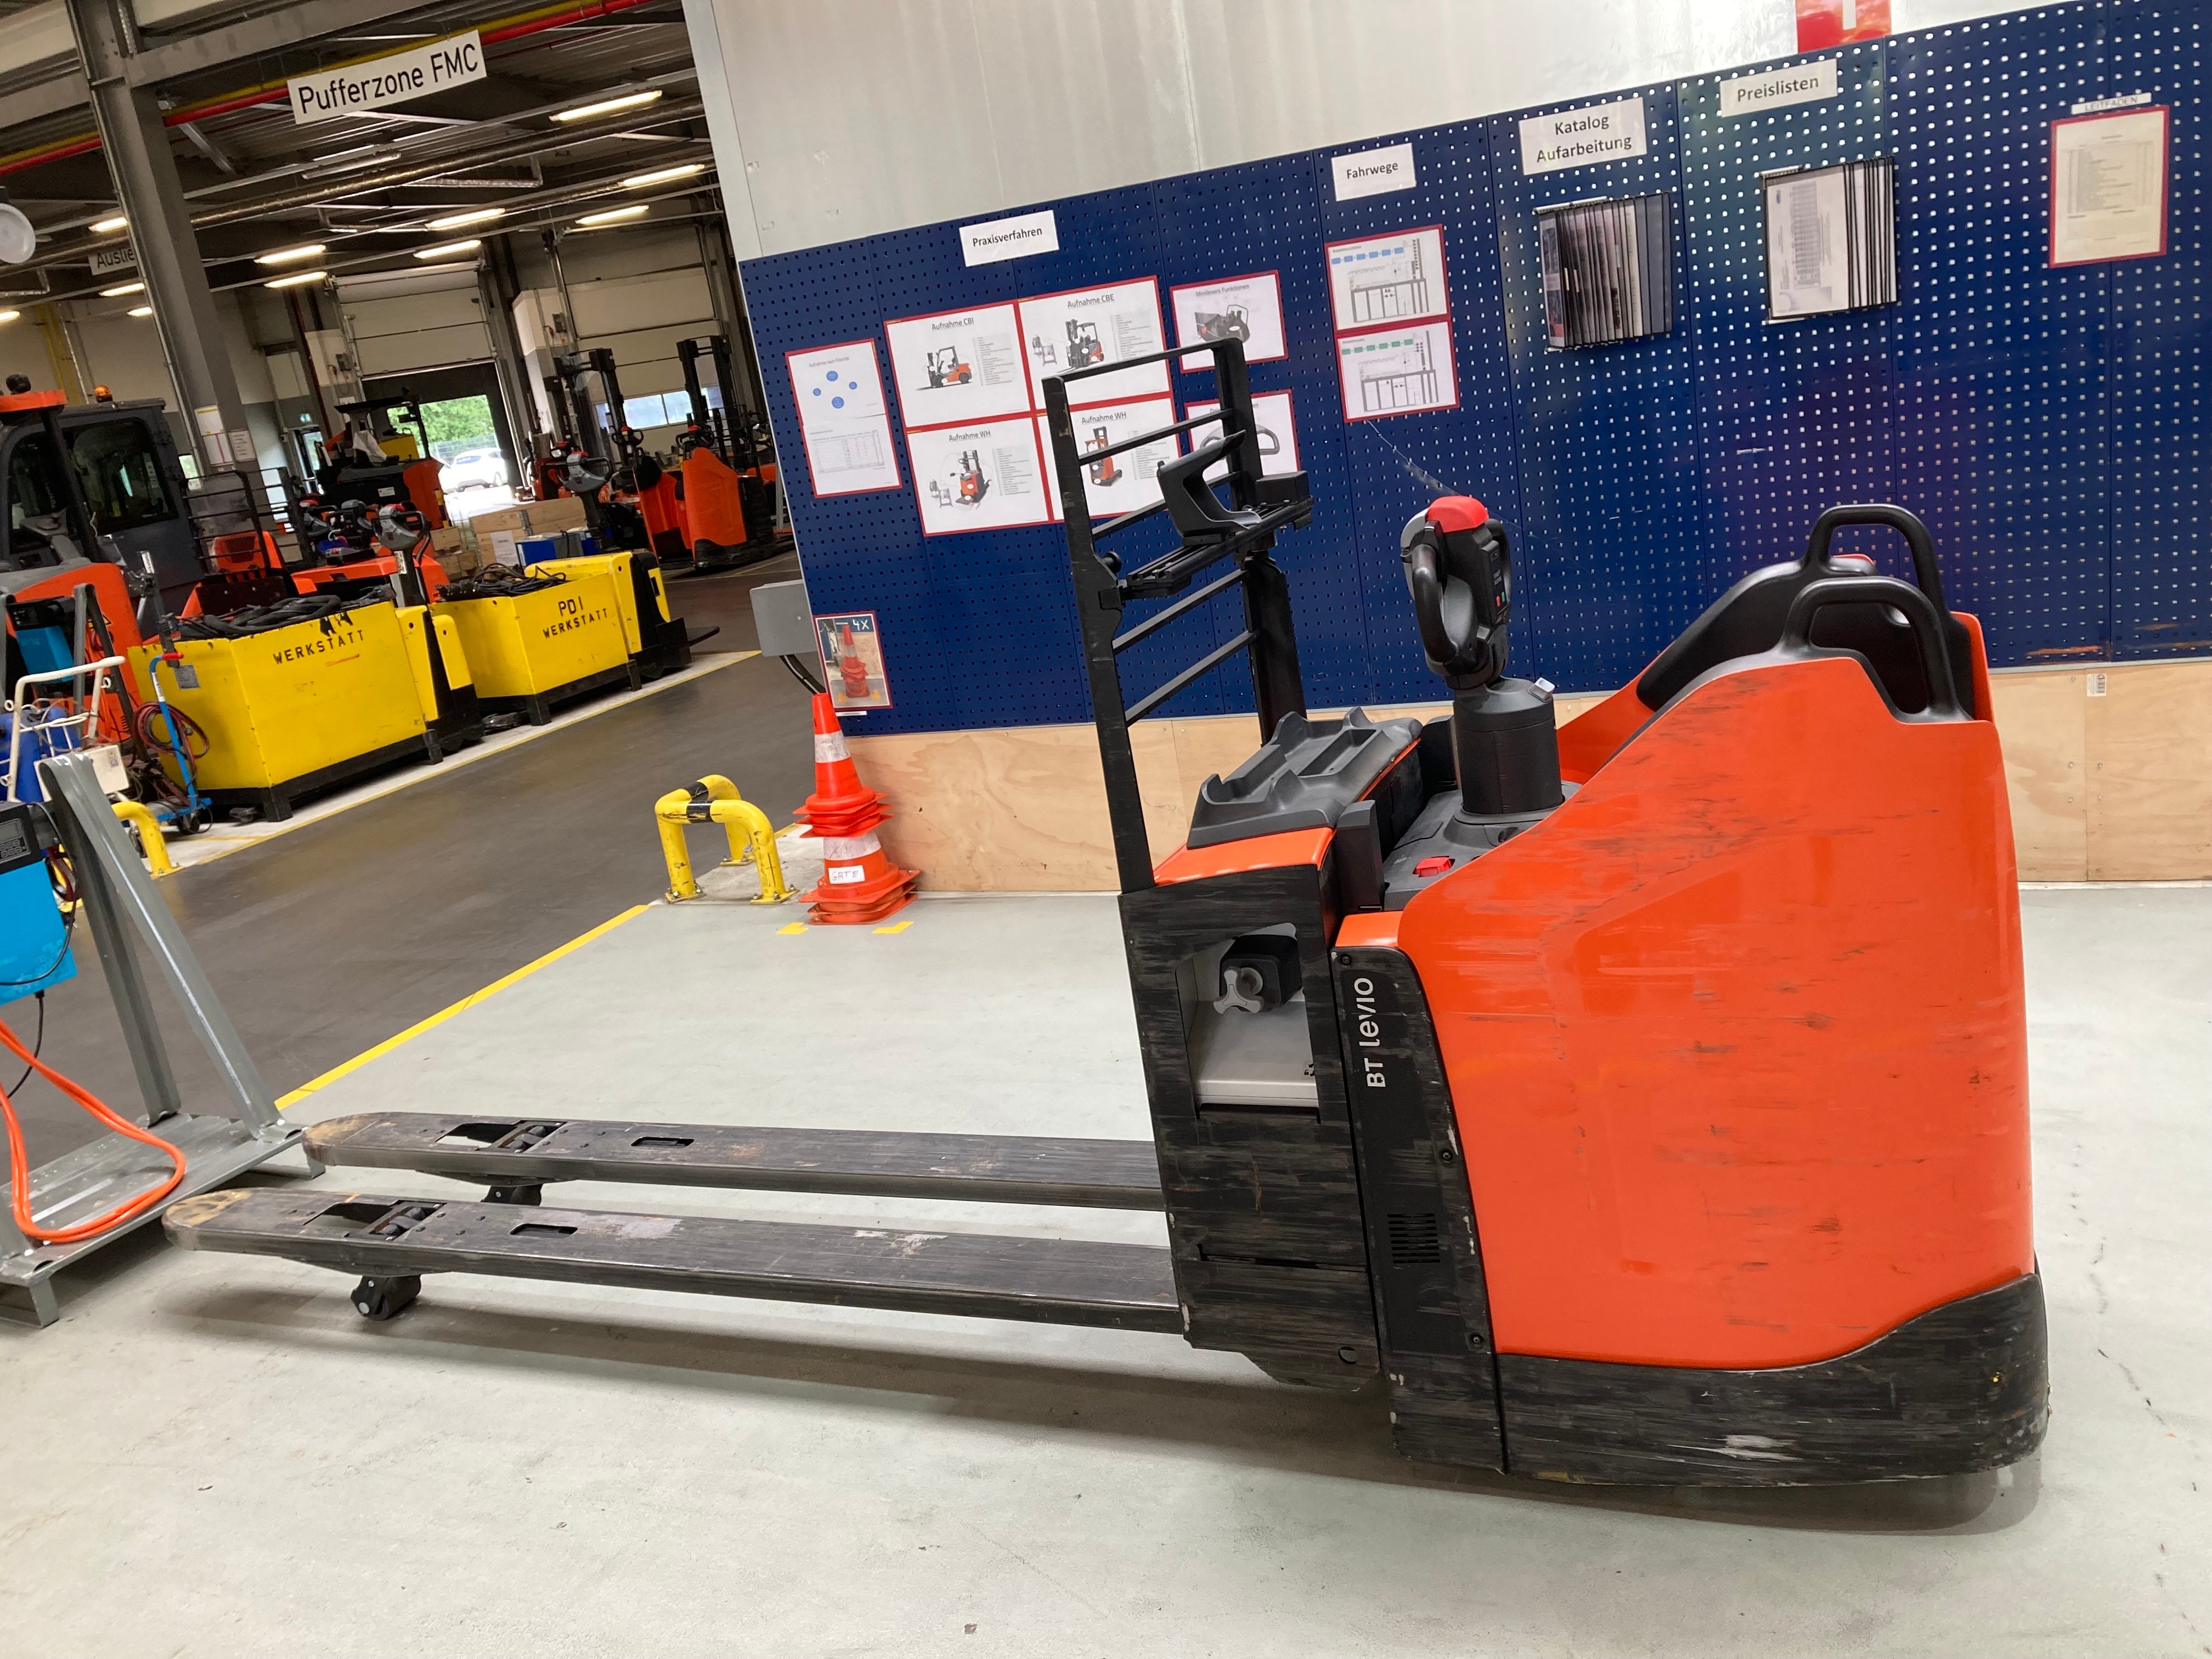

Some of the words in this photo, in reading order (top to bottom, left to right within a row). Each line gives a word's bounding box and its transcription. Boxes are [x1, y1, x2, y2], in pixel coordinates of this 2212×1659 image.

[298, 67, 423, 114] Pufferzone
[430, 43, 478, 83] FMC
[1737, 77, 1819, 102] Preislisten
[1555, 116, 1610, 136] Katalog
[1537, 137, 1632, 163] Aufarbeitung
[1346, 162, 1398, 179] Fahrwege
[972, 228, 1042, 247] Praxisverfahren
[1068, 296, 1100, 308] Aufnahme
[1101, 294, 1115, 302] CBE
[932, 319, 962, 330] Aufnahme
[963, 317, 974, 325] CBI
[1081, 414, 1114, 424] Aufnahme
[1114, 411, 1127, 420] WH
[949, 431, 979, 442] Aufnahme
[558, 595, 584, 617] PDI
[542, 608, 607, 639] WERKSTATT
[273, 629, 364, 665] WERKSTATT
[831, 870, 859, 882] GATE
[1363, 1057, 1386, 1088] BT
